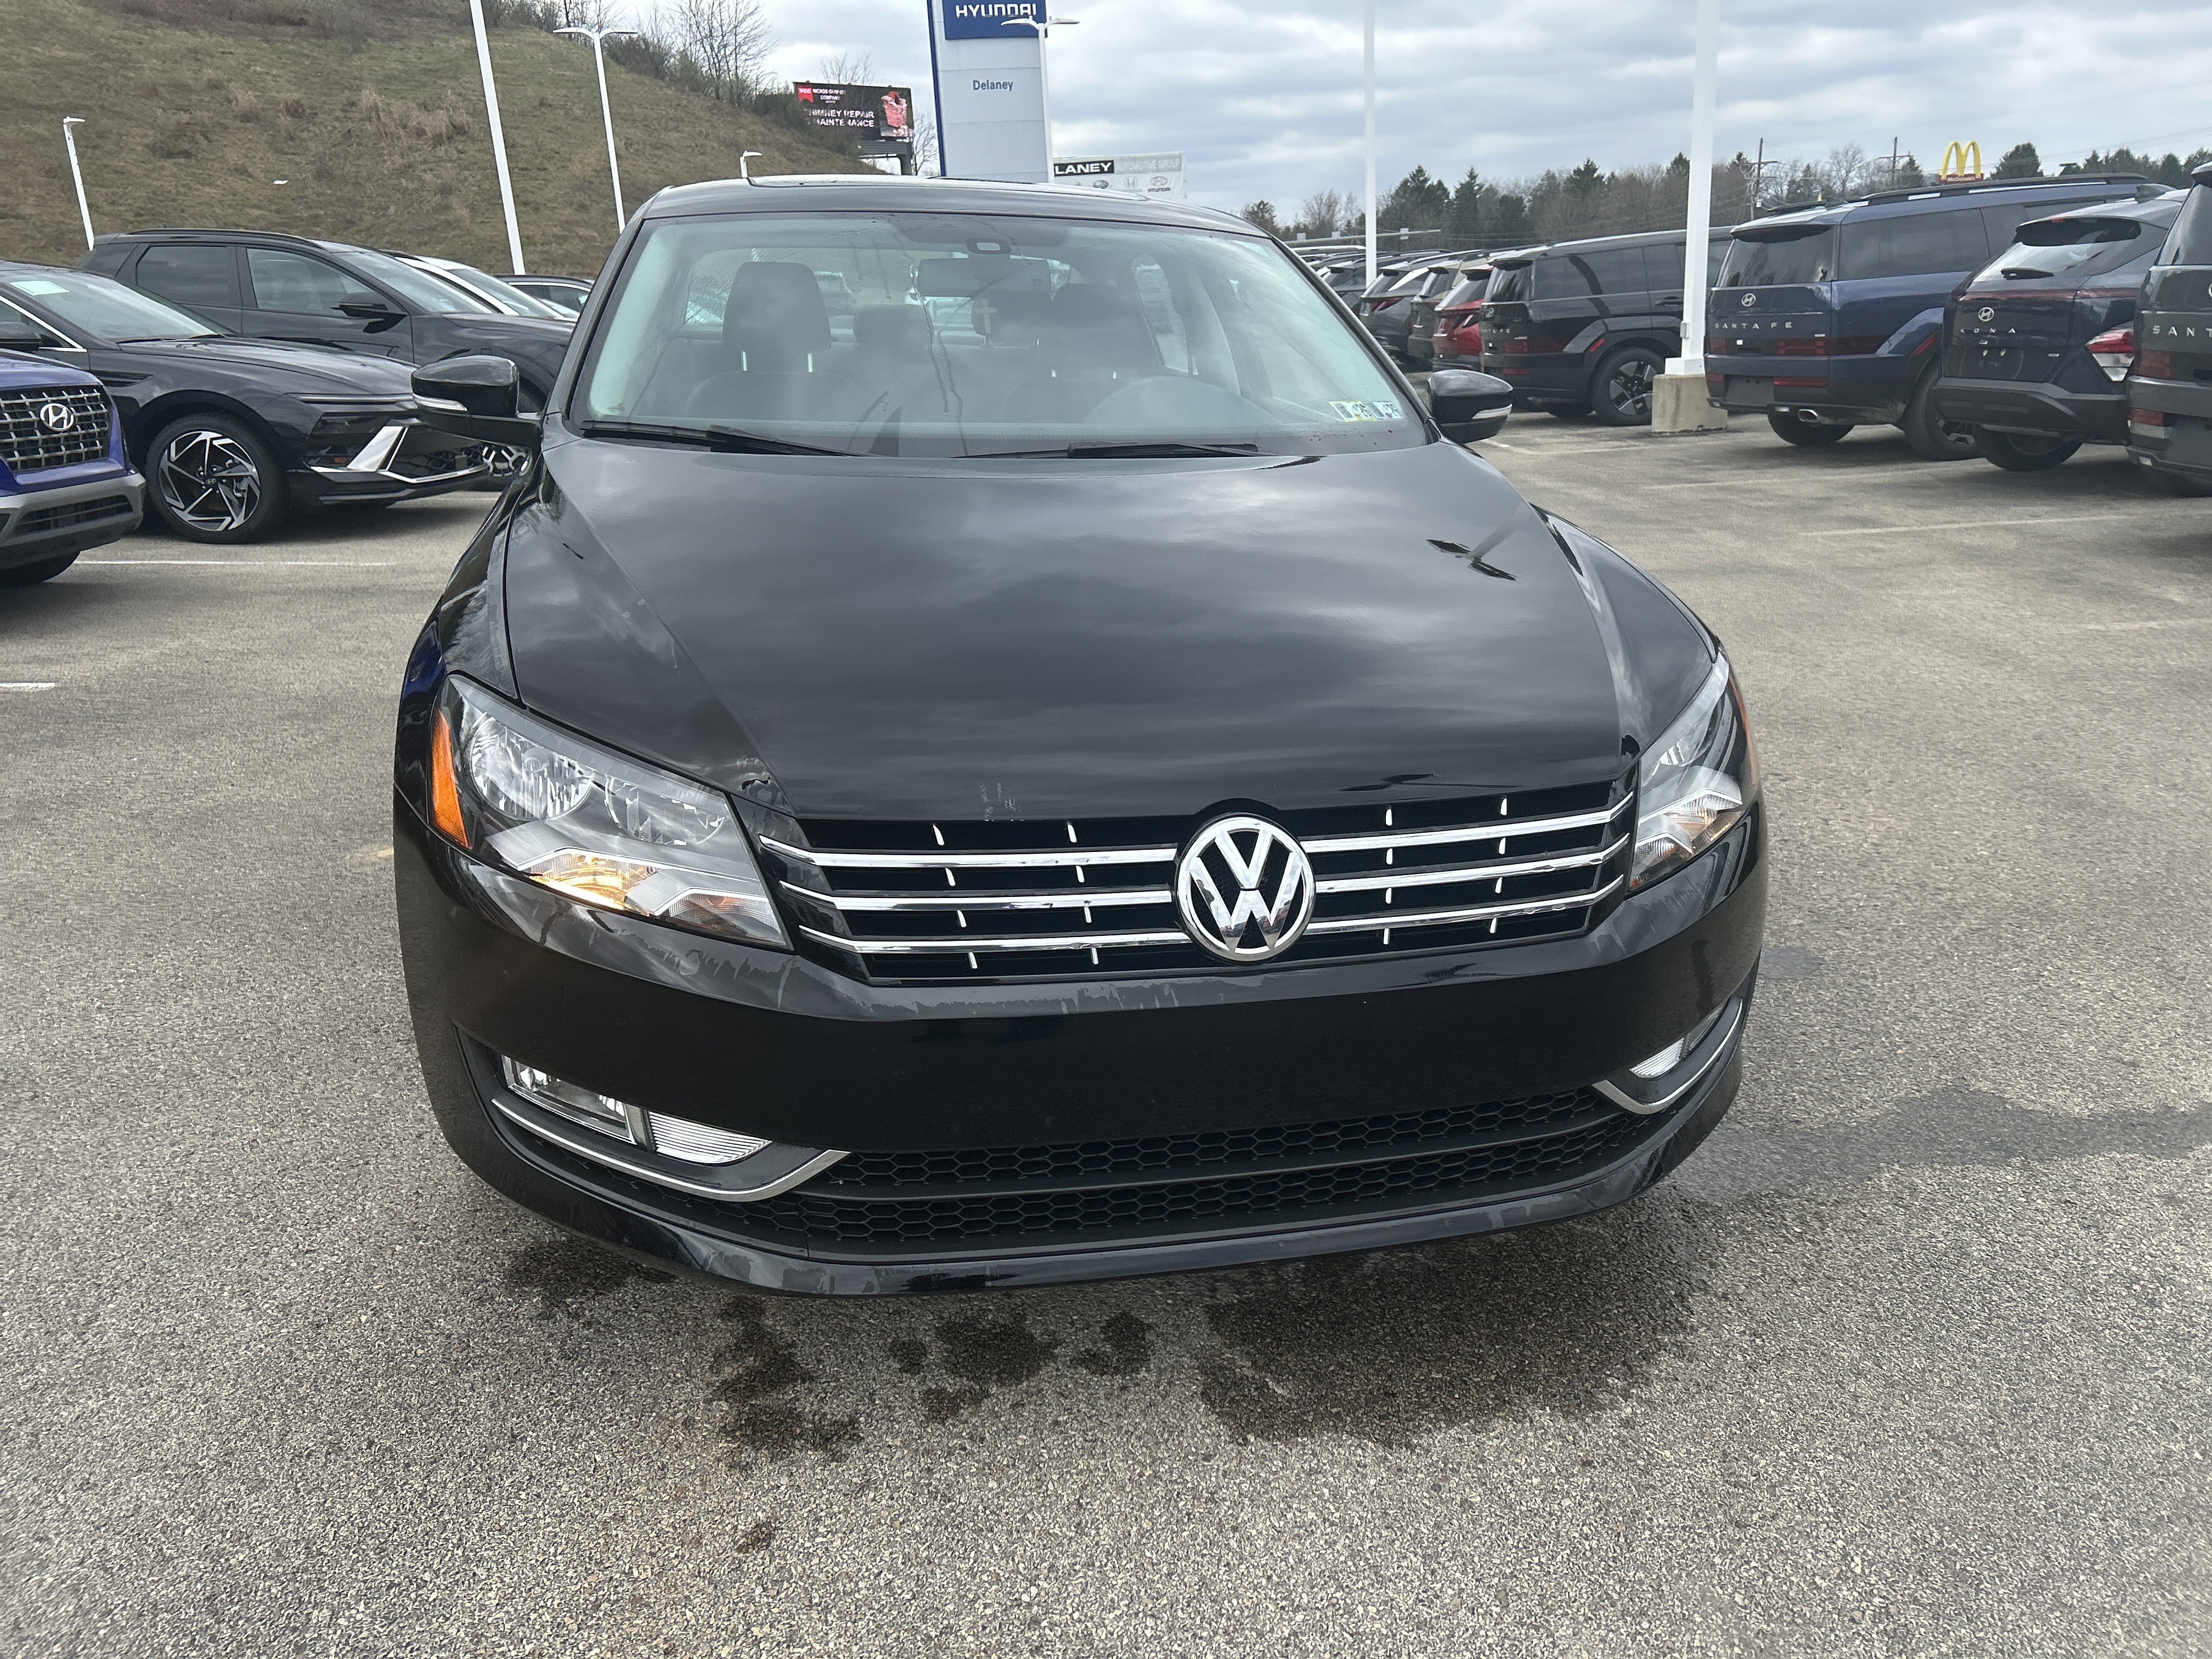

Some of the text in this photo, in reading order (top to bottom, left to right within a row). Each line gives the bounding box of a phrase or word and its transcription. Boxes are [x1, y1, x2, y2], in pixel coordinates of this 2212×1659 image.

[955, 3, 1036, 18] HYUNDAI
[973, 80, 1013, 92] Delaney
[1054, 162, 1111, 174] LANEY
